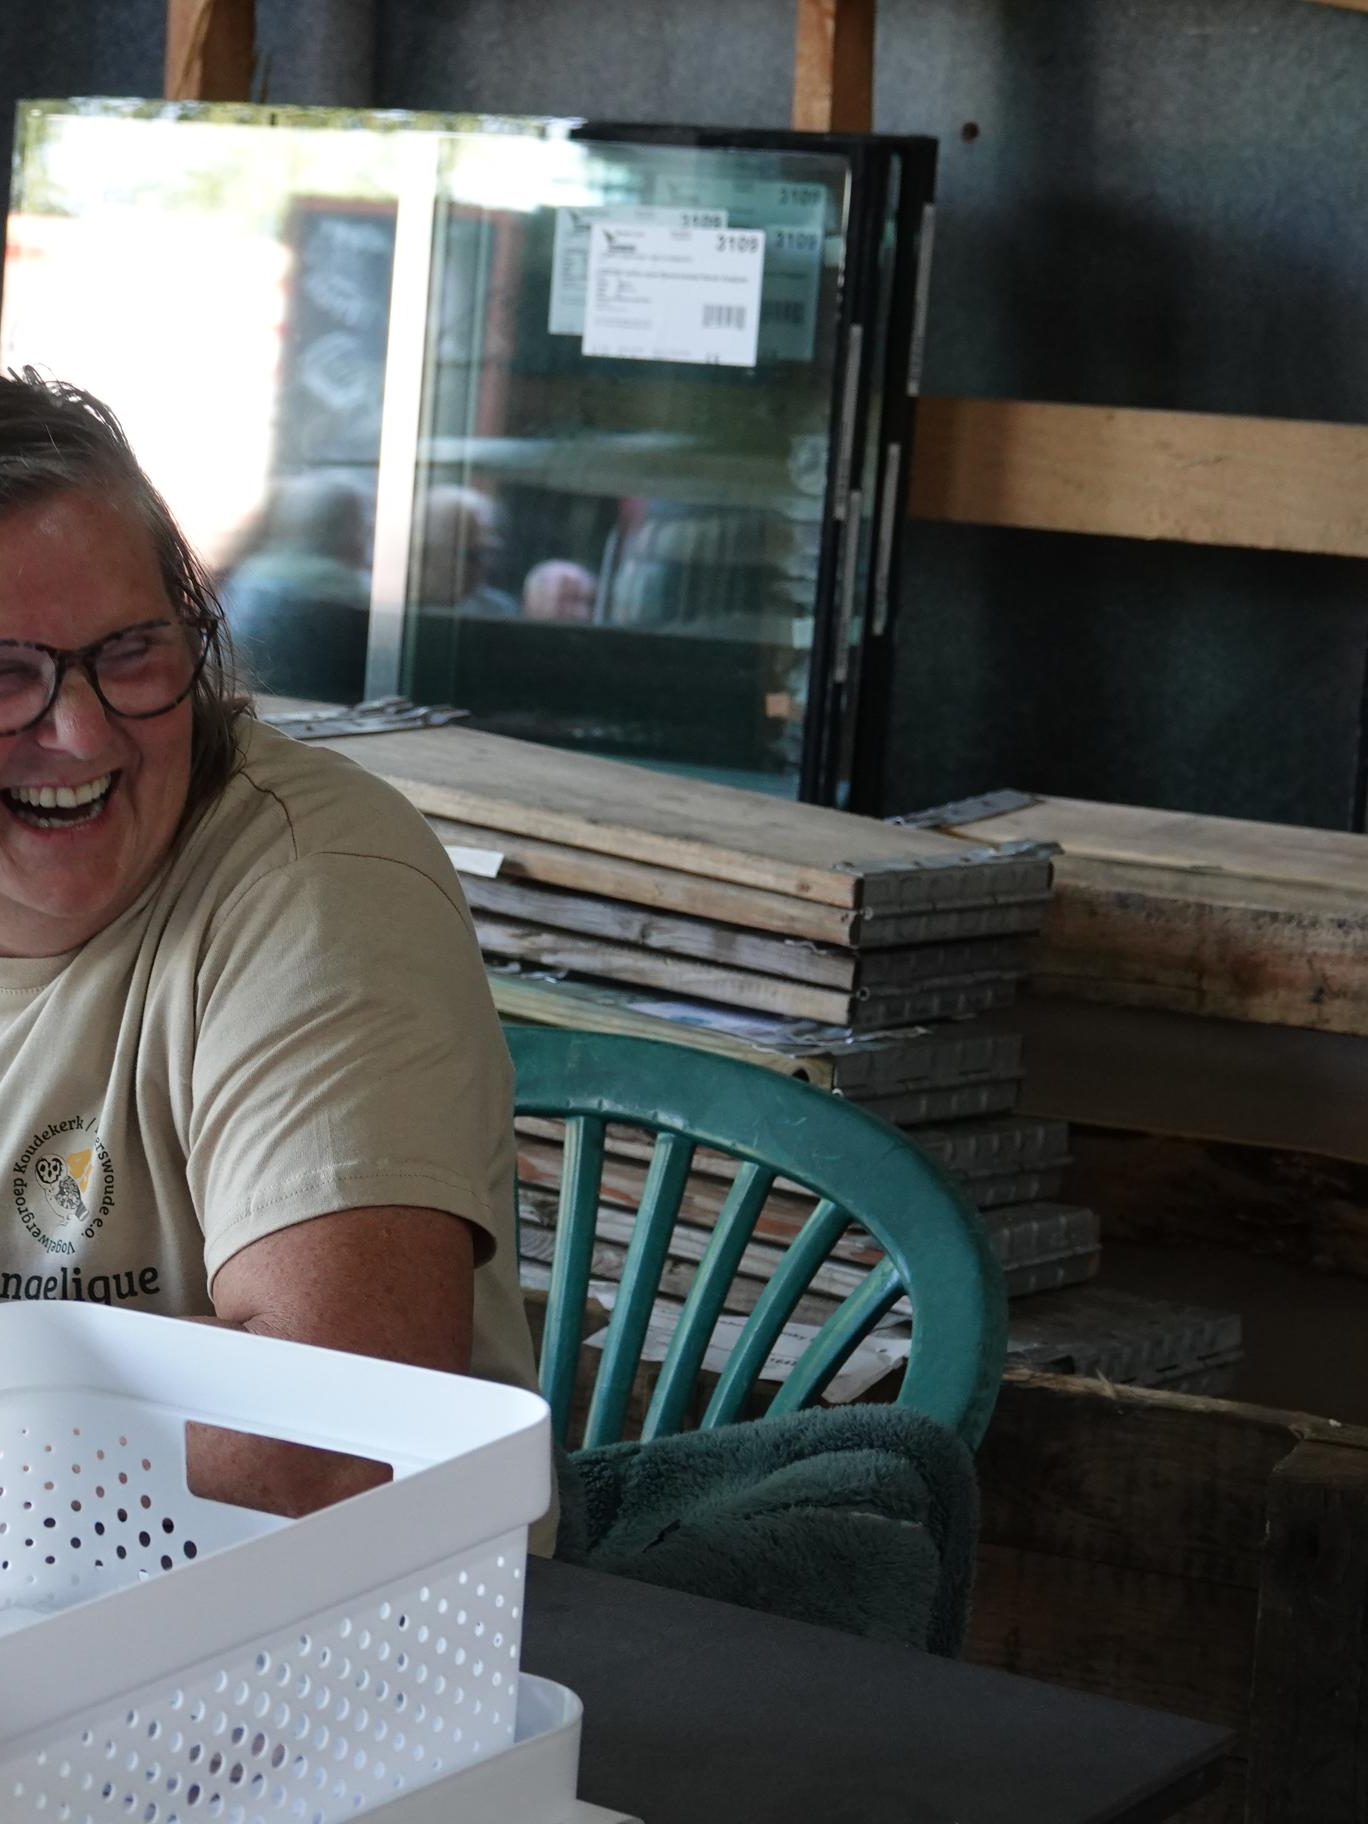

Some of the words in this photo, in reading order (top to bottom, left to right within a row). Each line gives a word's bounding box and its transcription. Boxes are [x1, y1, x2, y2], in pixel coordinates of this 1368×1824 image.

[715, 232, 760, 254] 3109
[14, 1116, 84, 1174] Koudekerk
[94, 1126, 115, 1216] erswoude
[13, 1178, 76, 1254] Vogelwergroep
[81, 1217, 103, 1239] e.o.
